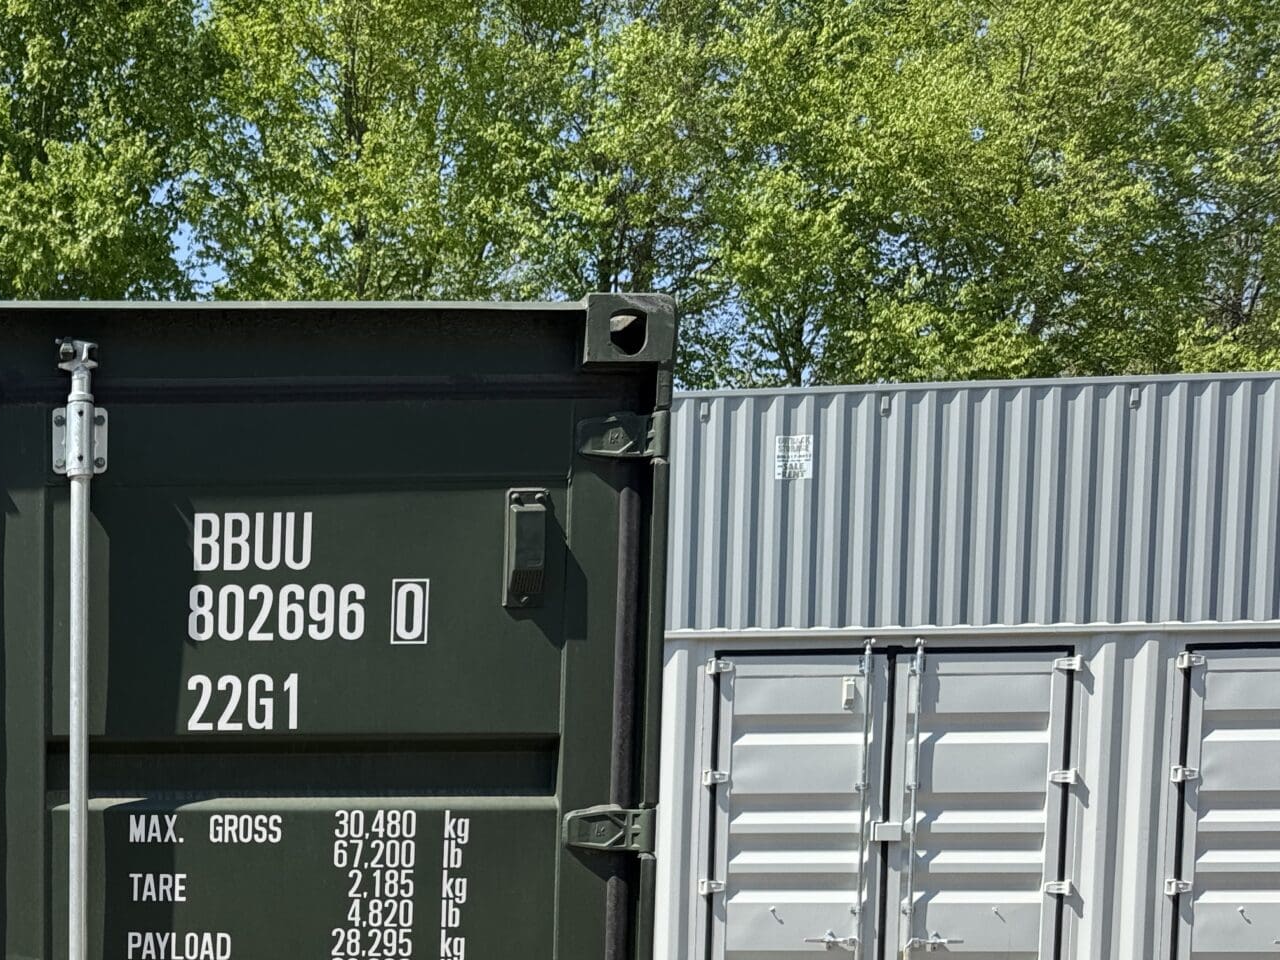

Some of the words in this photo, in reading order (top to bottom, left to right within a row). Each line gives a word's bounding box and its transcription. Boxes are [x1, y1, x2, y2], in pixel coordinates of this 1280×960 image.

[193, 511, 313, 571] BBUU
[188, 583, 366, 641] 802696
[396, 583, 424, 640] 0
[187, 673, 298, 731] 22G1
[129, 814, 184, 843] MAX.
[209, 814, 282, 843] GROSS
[334, 810, 417, 840] 30,480
[444, 810, 470, 844] kg
[333, 839, 416, 869] 67,200
[443, 840, 462, 868] lb
[129, 873, 187, 902] TARE
[348, 869, 414, 899] 2,185
[442, 870, 467, 903] kg
[347, 899, 414, 928] 4,820
[441, 899, 460, 928] lb
[128, 932, 232, 960] PAYLOAD
[331, 928, 412, 957] 28,295
